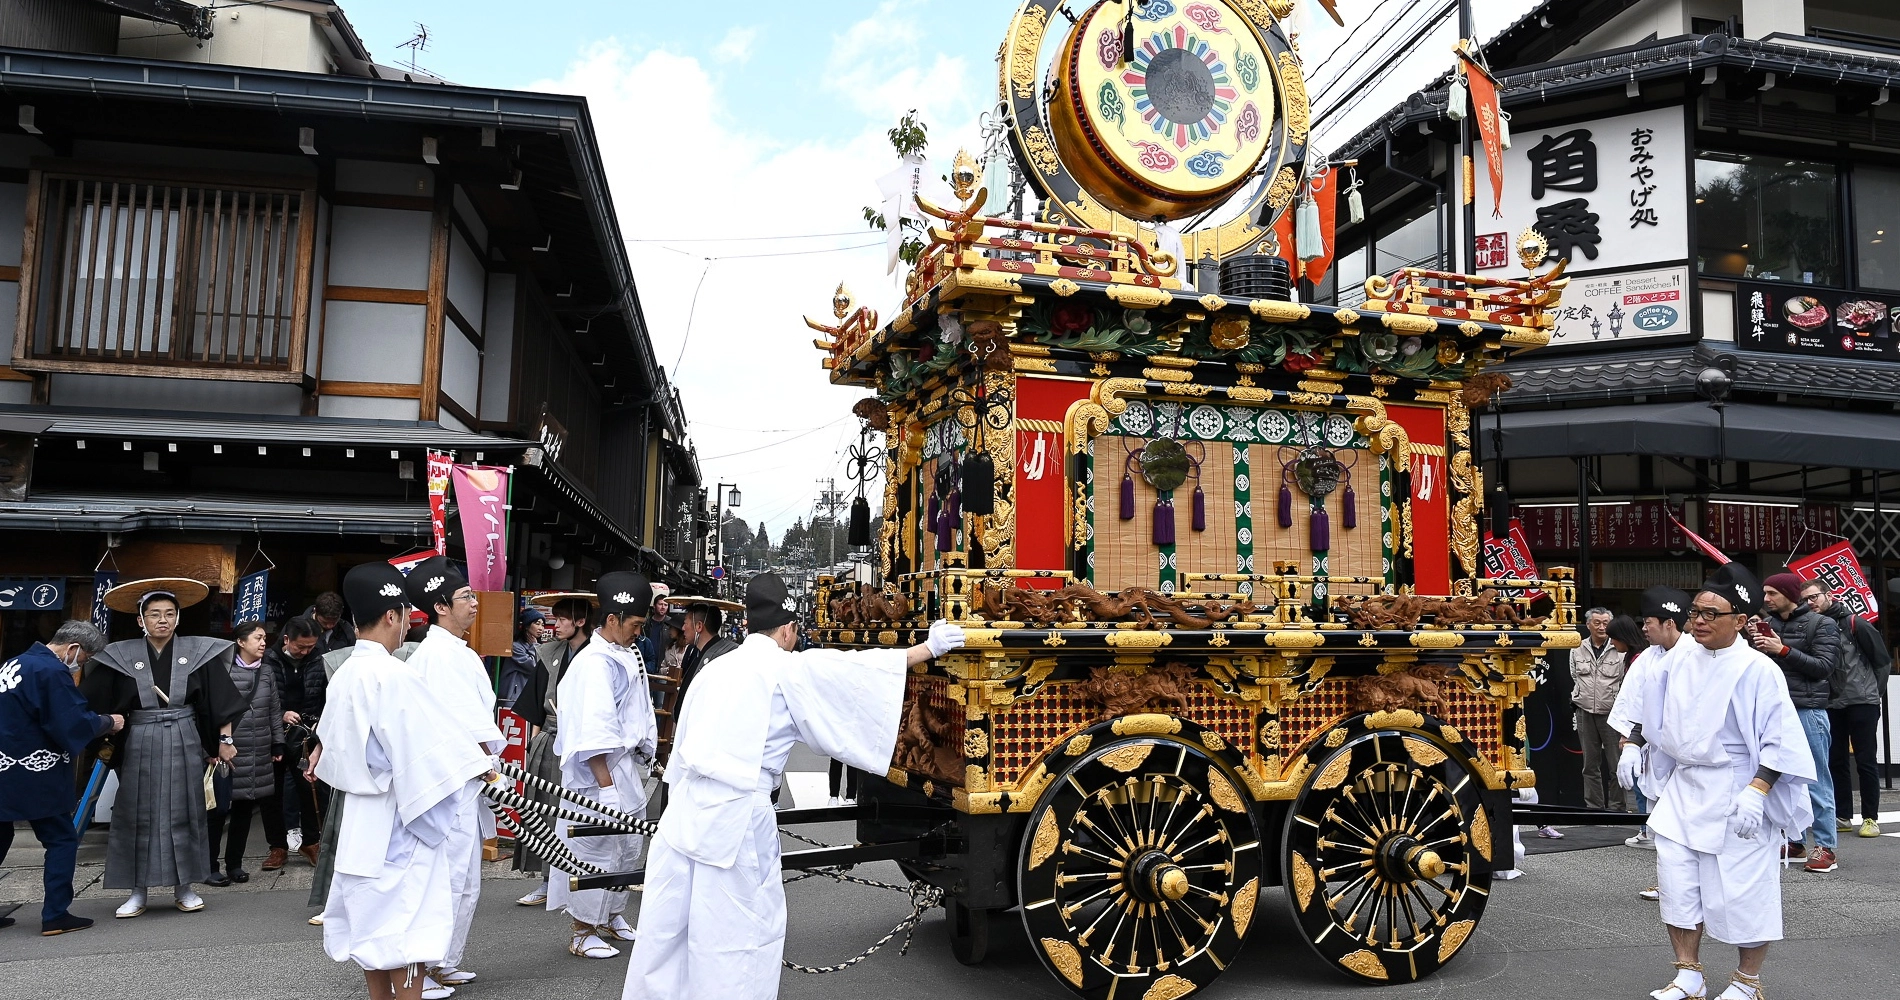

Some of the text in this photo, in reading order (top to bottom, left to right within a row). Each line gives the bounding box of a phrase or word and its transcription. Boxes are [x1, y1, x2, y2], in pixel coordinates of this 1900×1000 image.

[1629, 127, 1659, 229] おみやげ処
[1527, 129, 1602, 265] 角桑
[1584, 286, 1622, 298] COFFEE
[1625, 277, 1657, 286] Dessert
[1625, 281, 1672, 292] Sandwiches
[1626, 291, 1677, 304] 2階へどうぞ
[1548, 304, 1593, 321] ツ定食
[1638, 307, 1673, 318] coffee tea
[1518, 509, 1526, 529] ソフト
[1536, 508, 1544, 546] 生ビール
[1608, 514, 1616, 546] メンチカツ
[1627, 512, 1635, 546] カレーパン
[1650, 505, 1660, 546] 高山ラーメン
[1813, 563, 1869, 616] 甘酒
